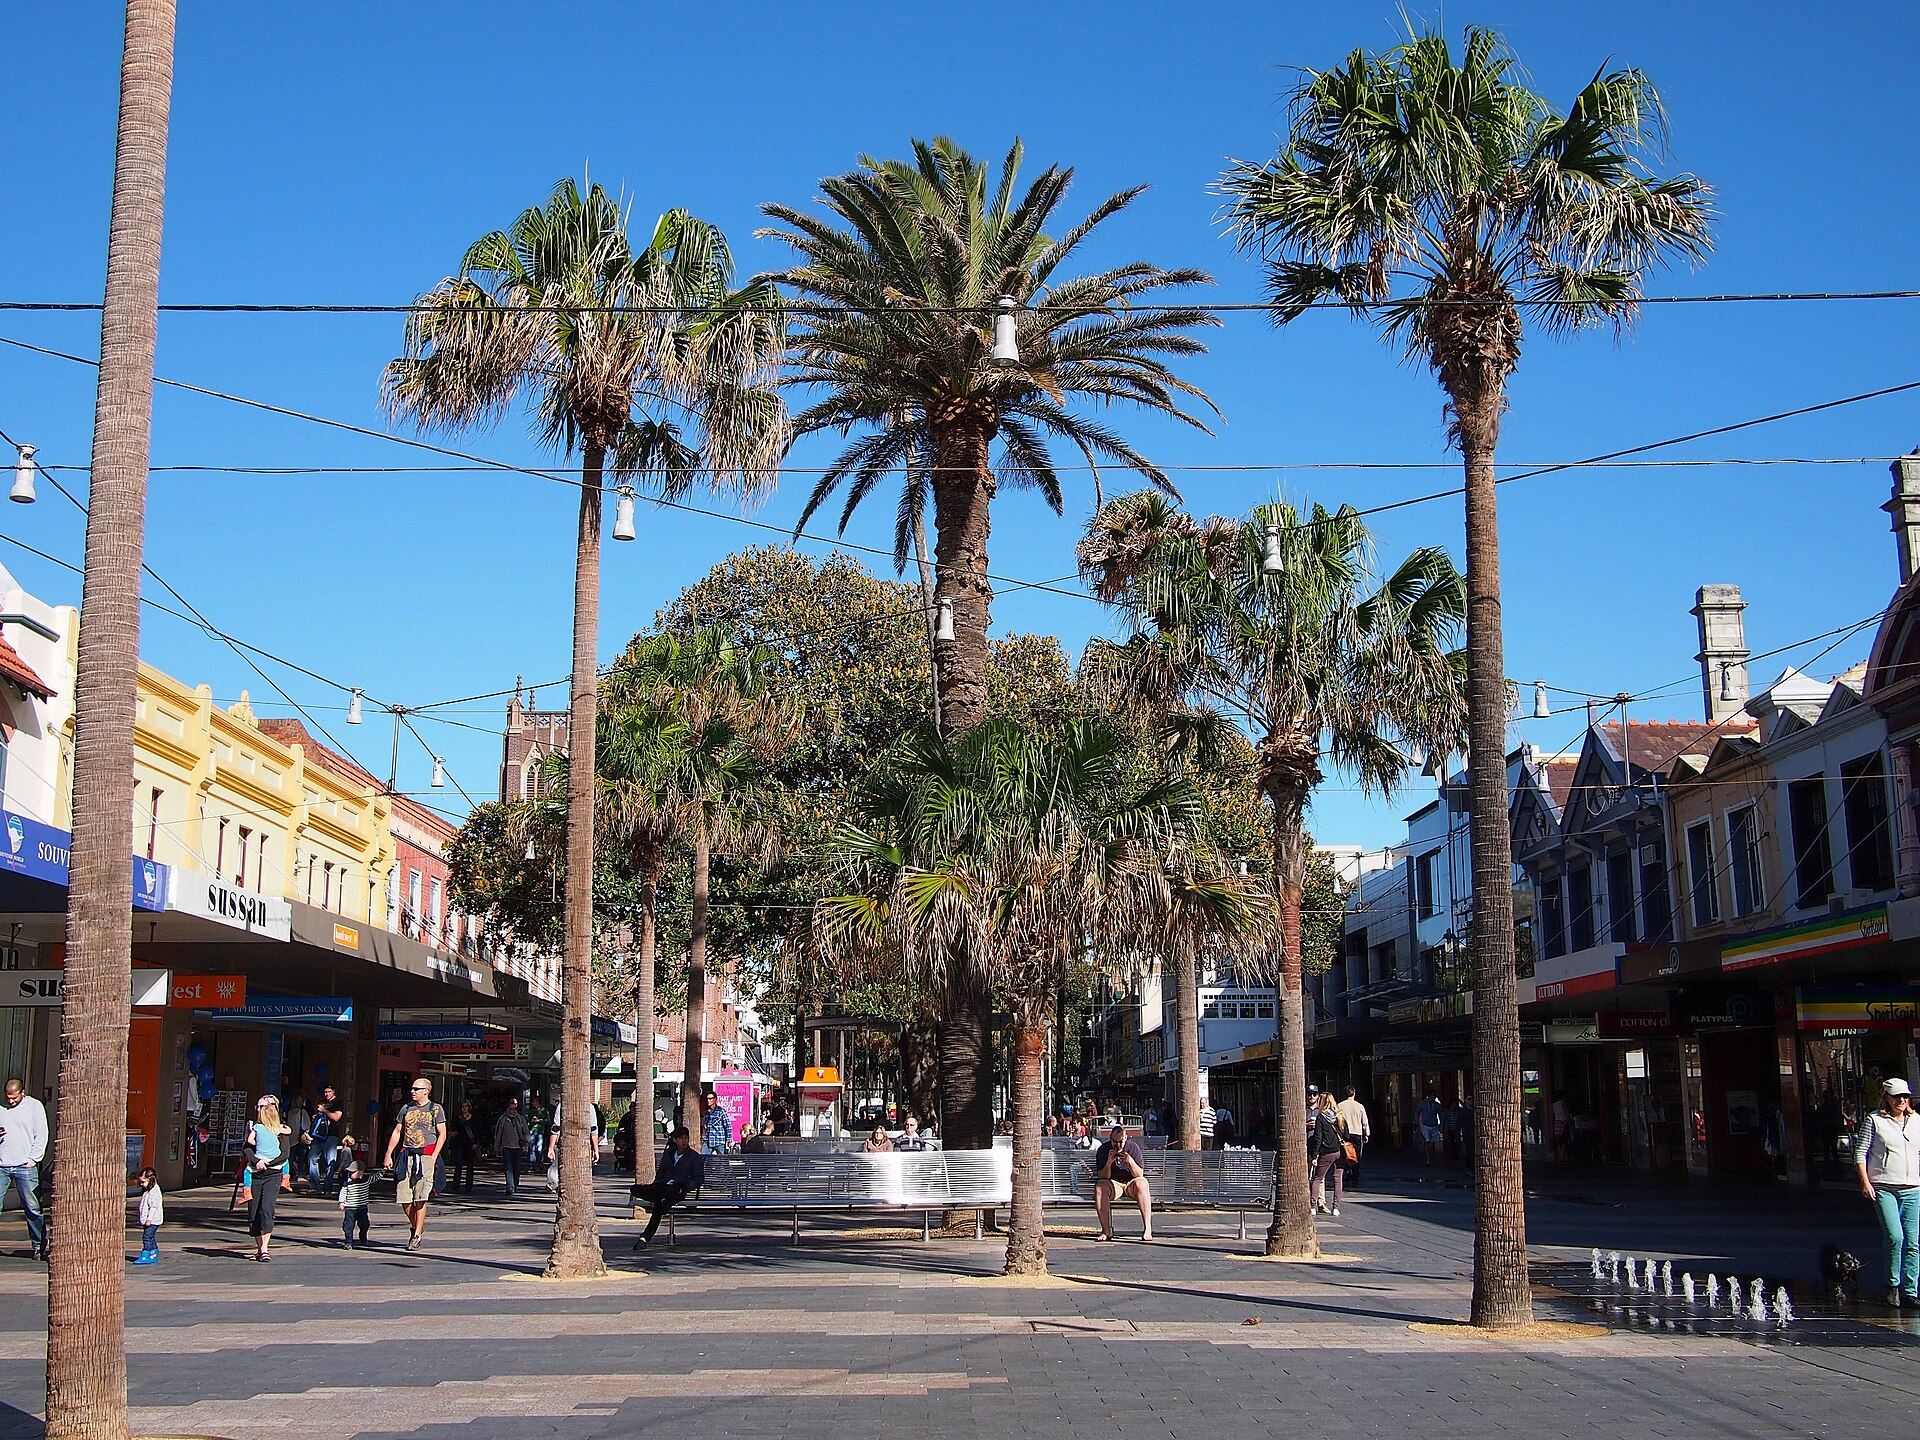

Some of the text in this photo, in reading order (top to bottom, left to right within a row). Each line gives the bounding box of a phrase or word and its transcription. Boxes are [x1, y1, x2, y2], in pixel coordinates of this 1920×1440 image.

[208, 884, 267, 928] sussan
[171, 983, 203, 999] est
[218, 1005, 337, 1014] HUMPHREYS NEWSAGENCY
[1865, 1000, 1918, 1023] Sportsgirl
[1620, 1018, 1657, 1027] COTTON
[1690, 1015, 1734, 1023] PLATYPUS
[517, 1048, 529, 1056] 24
